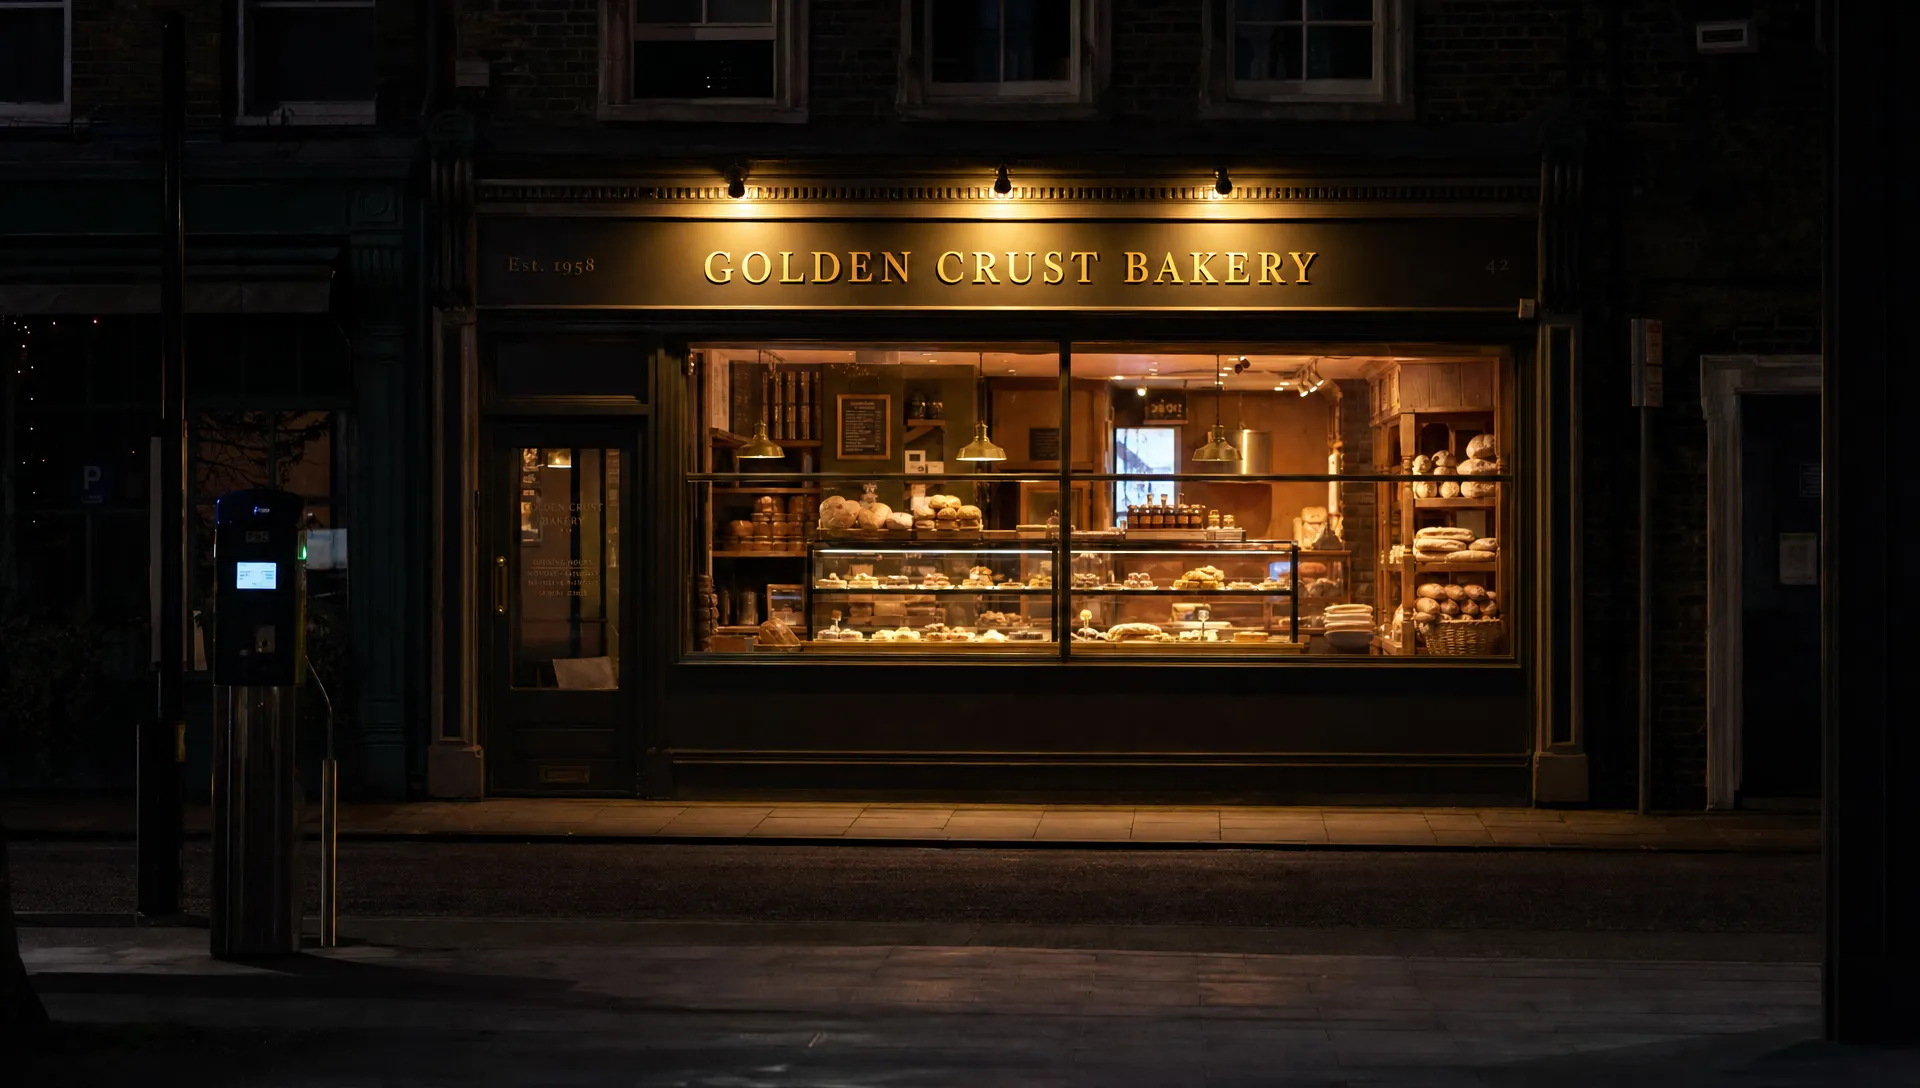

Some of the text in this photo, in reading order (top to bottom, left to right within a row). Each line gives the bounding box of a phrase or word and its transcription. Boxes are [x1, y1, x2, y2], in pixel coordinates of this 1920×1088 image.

[508, 256, 595, 276] Est. 1958
[703, 250, 1319, 285] GOLDEN CRUST BAKERY
[1485, 257, 1510, 275] 42
[82, 465, 103, 491] P
[569, 502, 604, 512] CRUST
[542, 516, 585, 526] BAKERY
